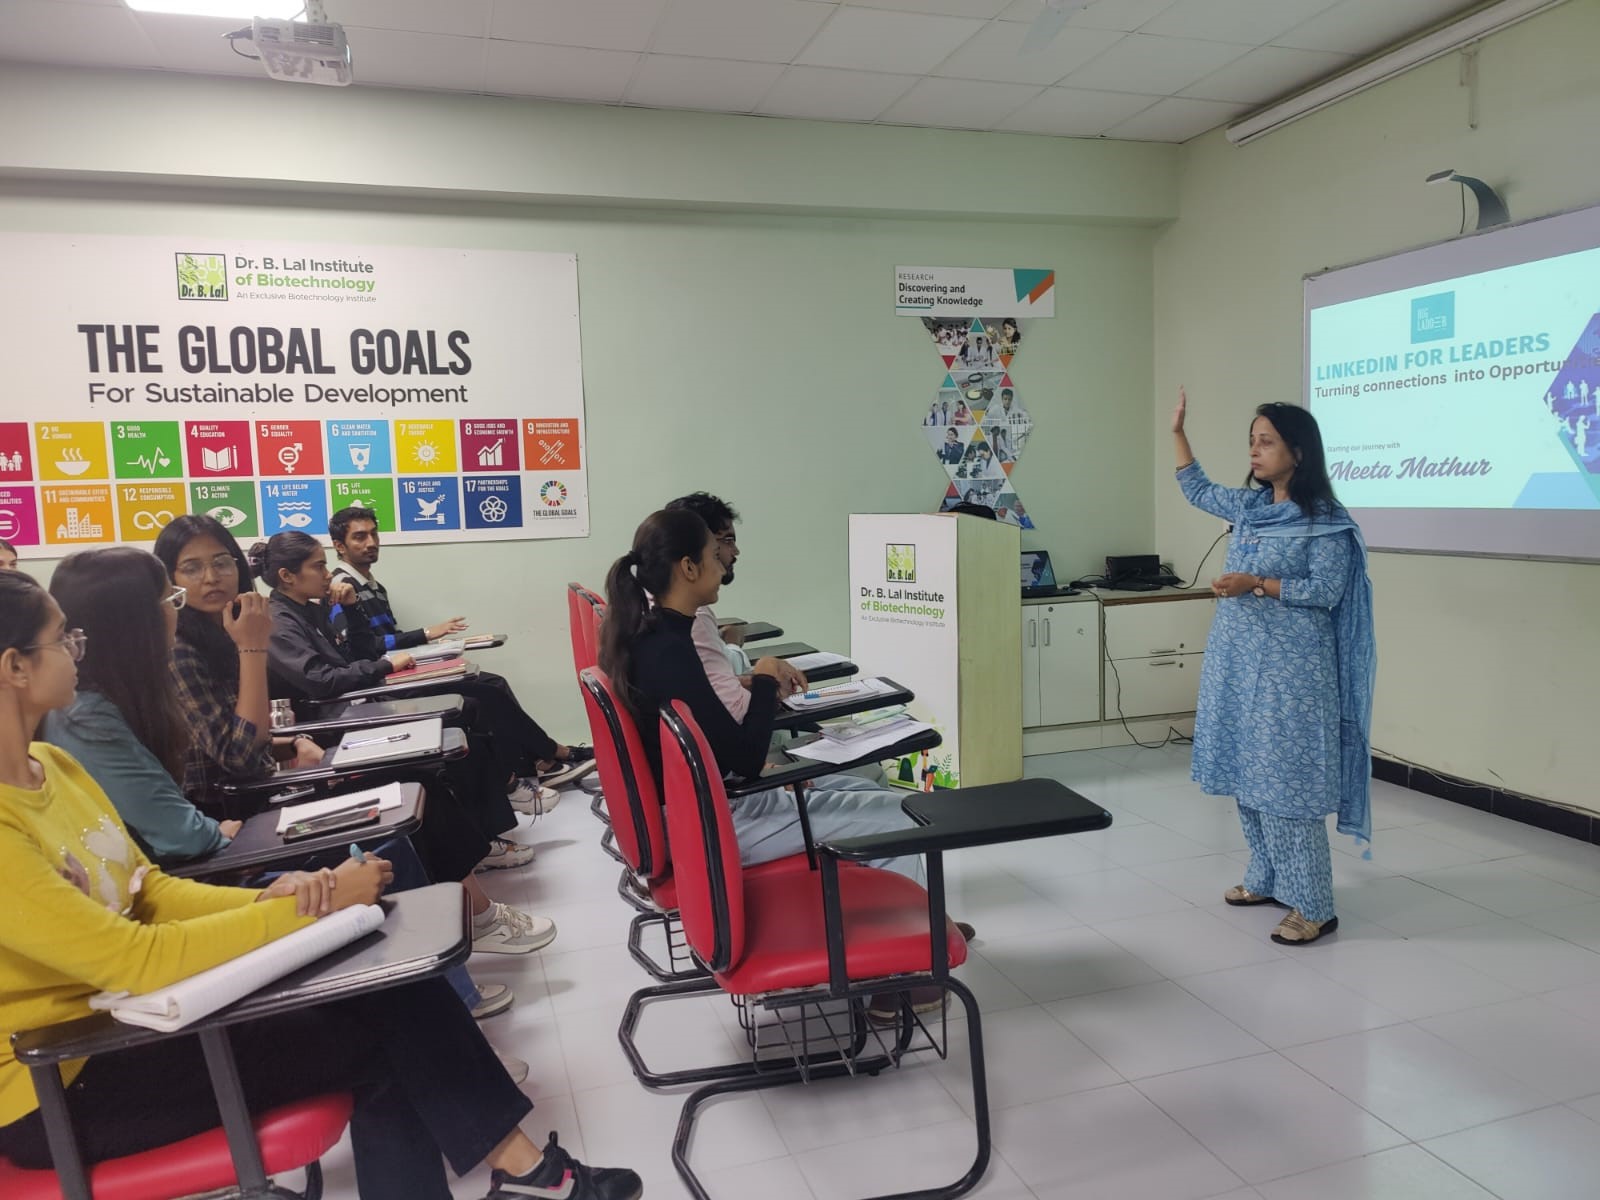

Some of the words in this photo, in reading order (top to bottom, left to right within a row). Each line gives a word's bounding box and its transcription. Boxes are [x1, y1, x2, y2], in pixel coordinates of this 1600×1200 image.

[235, 257, 258, 269] Dr.
[263, 258, 278, 270] B.
[283, 258, 306, 271] Lal
[310, 259, 374, 273] Institute
[235, 273, 253, 286] of
[257, 274, 375, 292] Biotechnology
[898, 282, 948, 294] Discovering
[950, 285, 966, 293] and
[182, 284, 194, 297] Dr.
[198, 285, 208, 298] B.
[210, 285, 224, 298] Lal
[250, 292, 286, 300] Exclusive
[288, 293, 344, 303] Biotechnology
[346, 294, 376, 302] Institute
[898, 295, 934, 306] Creating
[936, 296, 983, 307] Knowledge
[77, 324, 163, 374] THE
[178, 325, 336, 374] GLOBAL
[350, 328, 472, 376] GOALS
[1316, 355, 1398, 380] LINKEDIN
[1404, 348, 1443, 370] FOR
[1449, 332, 1550, 363] LEADERS
[1314, 384, 1360, 398] Turning
[1363, 374, 1448, 393] connections
[1454, 369, 1485, 383] into
[89, 382, 135, 403] For
[145, 382, 294, 404] Sustainable
[304, 384, 468, 407] Development
[41, 426, 50, 440] 2
[117, 425, 126, 438] 3
[190, 424, 198, 438] 4
[261, 424, 268, 437] 5
[332, 424, 339, 436] 6
[400, 423, 406, 436] 7
[465, 423, 472, 435] 8
[527, 422, 534, 434] 9
[1329, 460, 1393, 481] Meeta
[1396, 456, 1492, 480] Mathur
[195, 486, 209, 499] 13
[266, 484, 279, 497] 14
[336, 483, 349, 495] 15
[403, 481, 415, 494] 16
[465, 480, 476, 492] 17
[44, 490, 56, 504] 11
[123, 488, 137, 501] 12
[904, 569, 914, 580] Lal
[861, 587, 874, 597] Dr.
[876, 588, 886, 598] B.
[888, 589, 902, 599] Lal
[904, 590, 944, 602] Institute
[860, 601, 870, 610] of
[873, 601, 945, 618] Biotechnology
